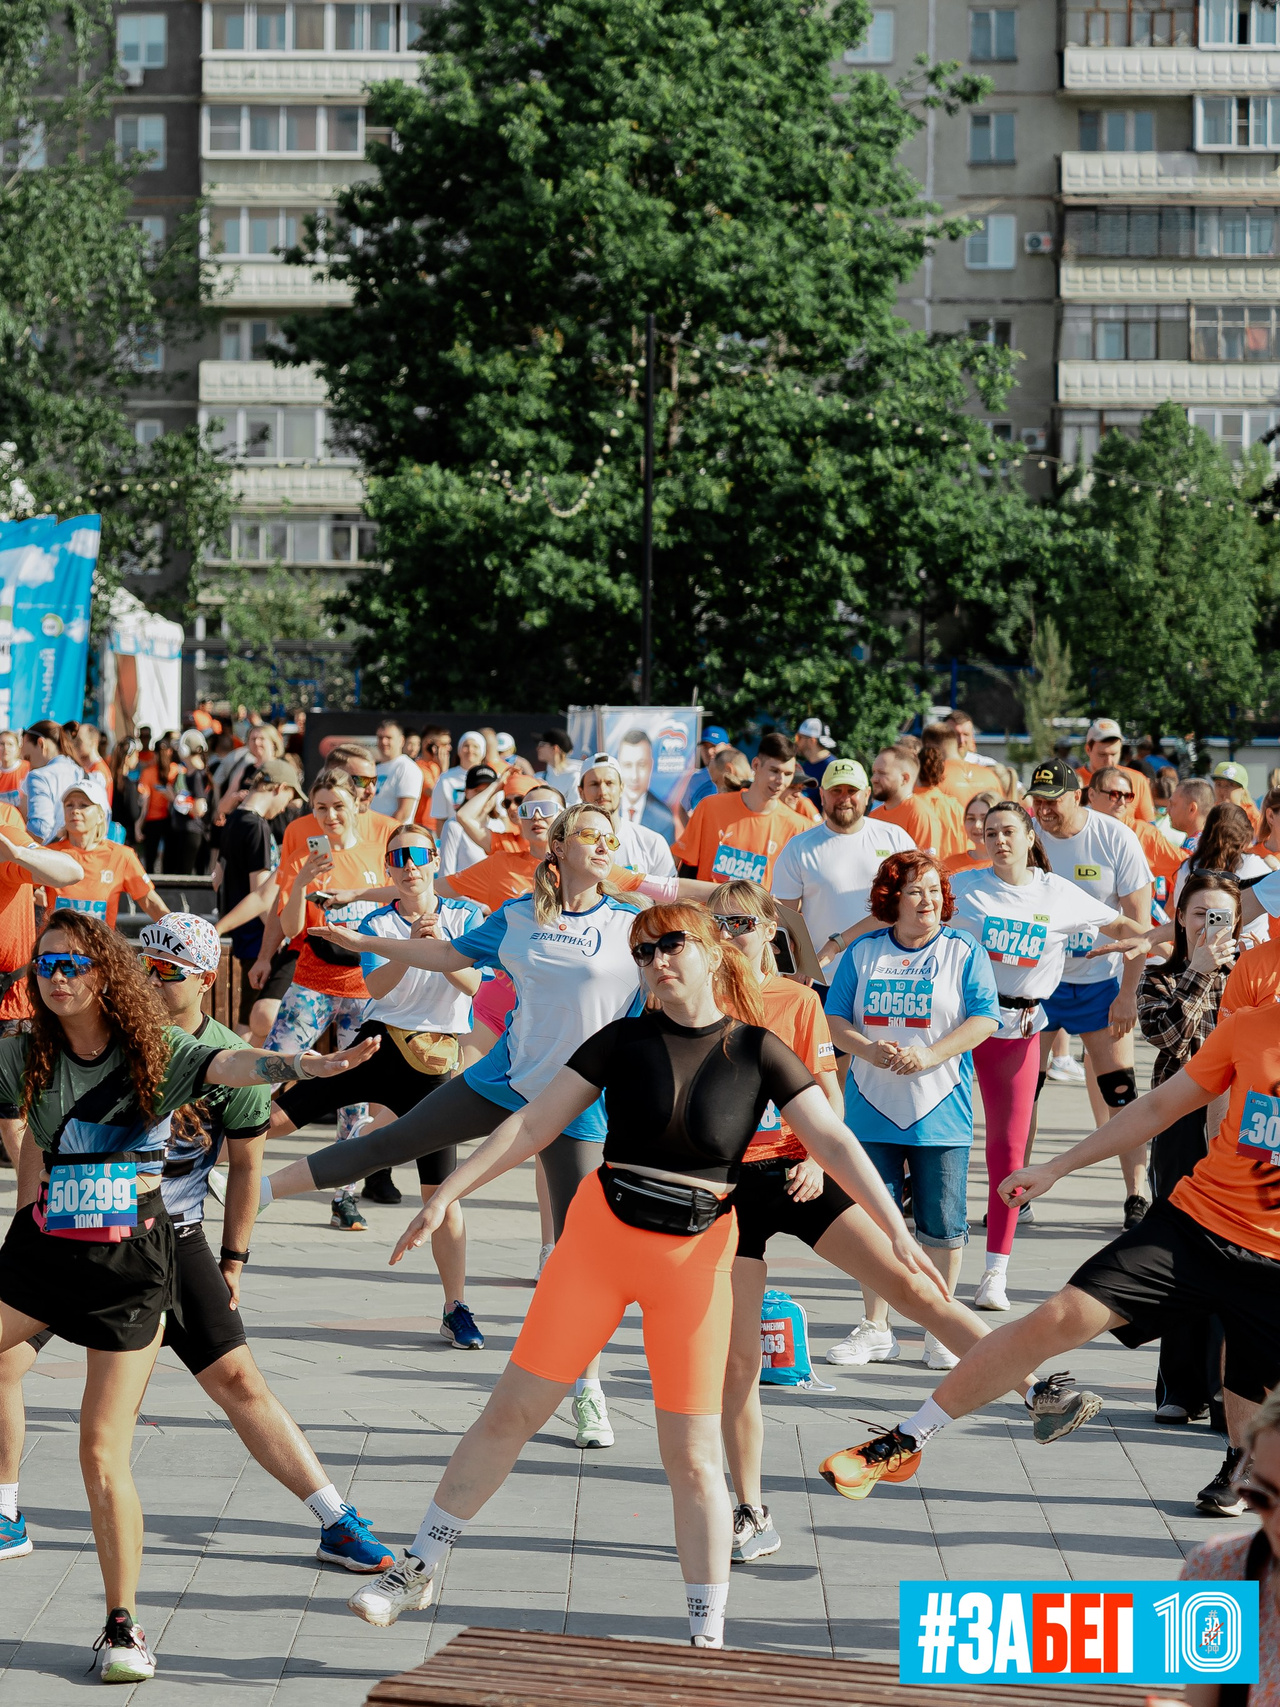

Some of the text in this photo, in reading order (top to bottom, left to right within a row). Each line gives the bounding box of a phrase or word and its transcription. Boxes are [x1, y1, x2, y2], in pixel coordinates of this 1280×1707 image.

[716, 854, 762, 884] 30254
[1077, 868, 1097, 877] LD
[539, 932, 593, 948] БАЛТИКА
[985, 927, 1042, 958] 30748
[884, 966, 932, 976] БАЛТИКА
[867, 991, 929, 1017] 30563
[51, 1177, 131, 1214] 50299
[73, 1212, 104, 1229] 10КМ
